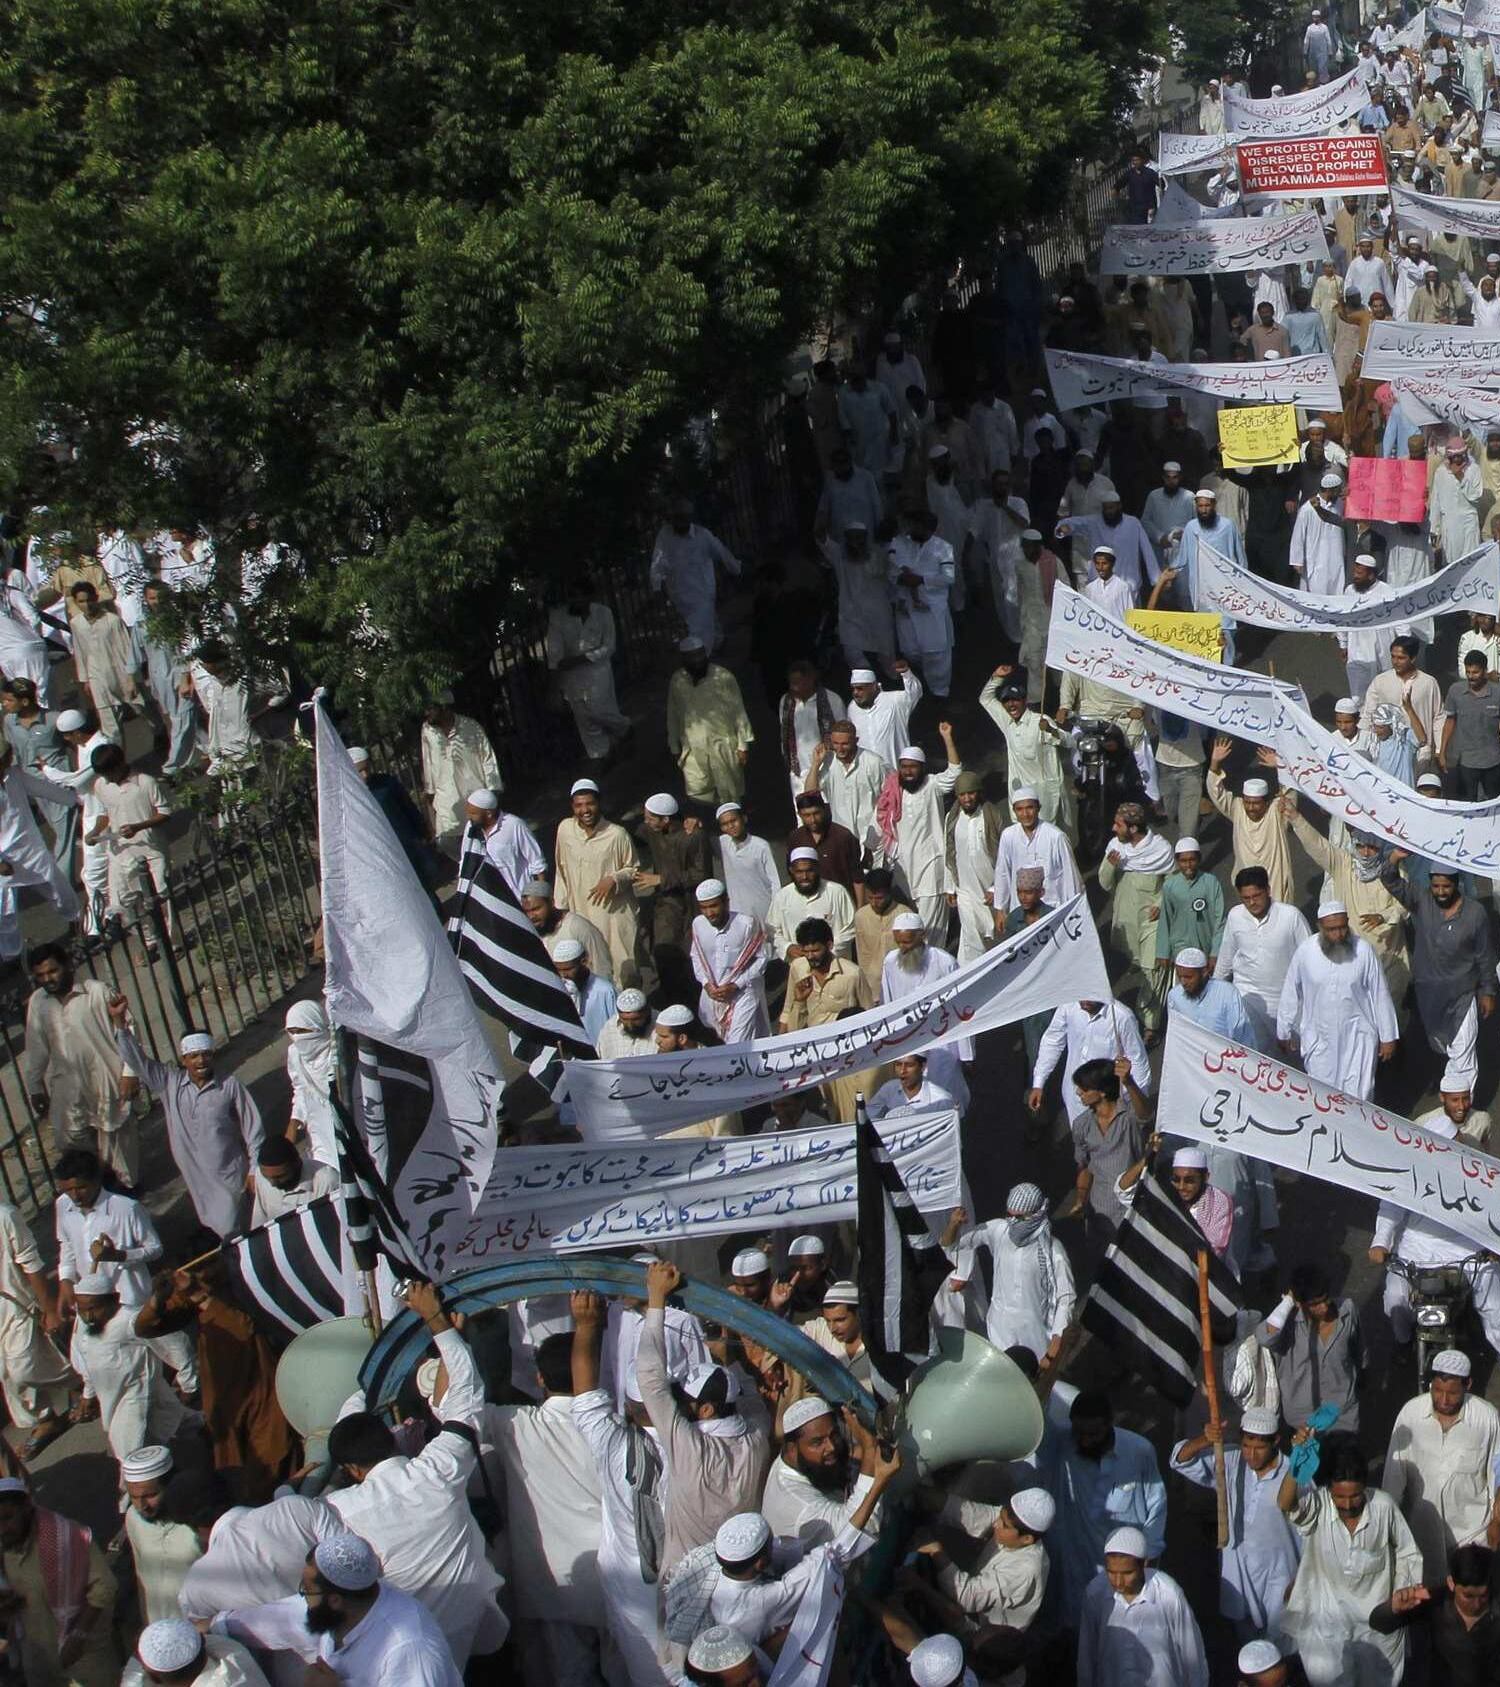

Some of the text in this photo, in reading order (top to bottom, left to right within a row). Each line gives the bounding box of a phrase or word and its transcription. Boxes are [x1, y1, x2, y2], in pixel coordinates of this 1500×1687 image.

[1241, 140, 1378, 157] WE PROTEST AGAINST
[1248, 150, 1376, 166] DISRESPECT OF OUR
[1253, 160, 1374, 175] BELOVED PROPHET
[1247, 173, 1336, 188] MUHAMMAD
[1124, 251, 1164, 269] نبوت
[1273, 239, 1310, 261] عالمی
[1266, 601, 1285, 619] عالمی
[1065, 647, 1096, 670] نبوت
[1107, 660, 1131, 682] تحفظ
[1156, 678, 1181, 696] عالمی
[931, 1002, 975, 1037] عالمی
[1267, 1066, 1289, 1097] بھی
[1199, 1089, 1313, 1143] کراچی
[1372, 1111, 1392, 1131] کی
[582, 1156, 603, 1184] کا
[599, 1155, 648, 1190] محبت
[650, 1160, 682, 1177] سے
[1307, 1123, 1418, 1199] اسلام
[916, 1166, 946, 1195] تمام
[1421, 1171, 1484, 1214] علماء
[678, 1199, 701, 1224] کا
[472, 1217, 514, 1256] مجلس
[512, 1213, 552, 1250] عالمی
